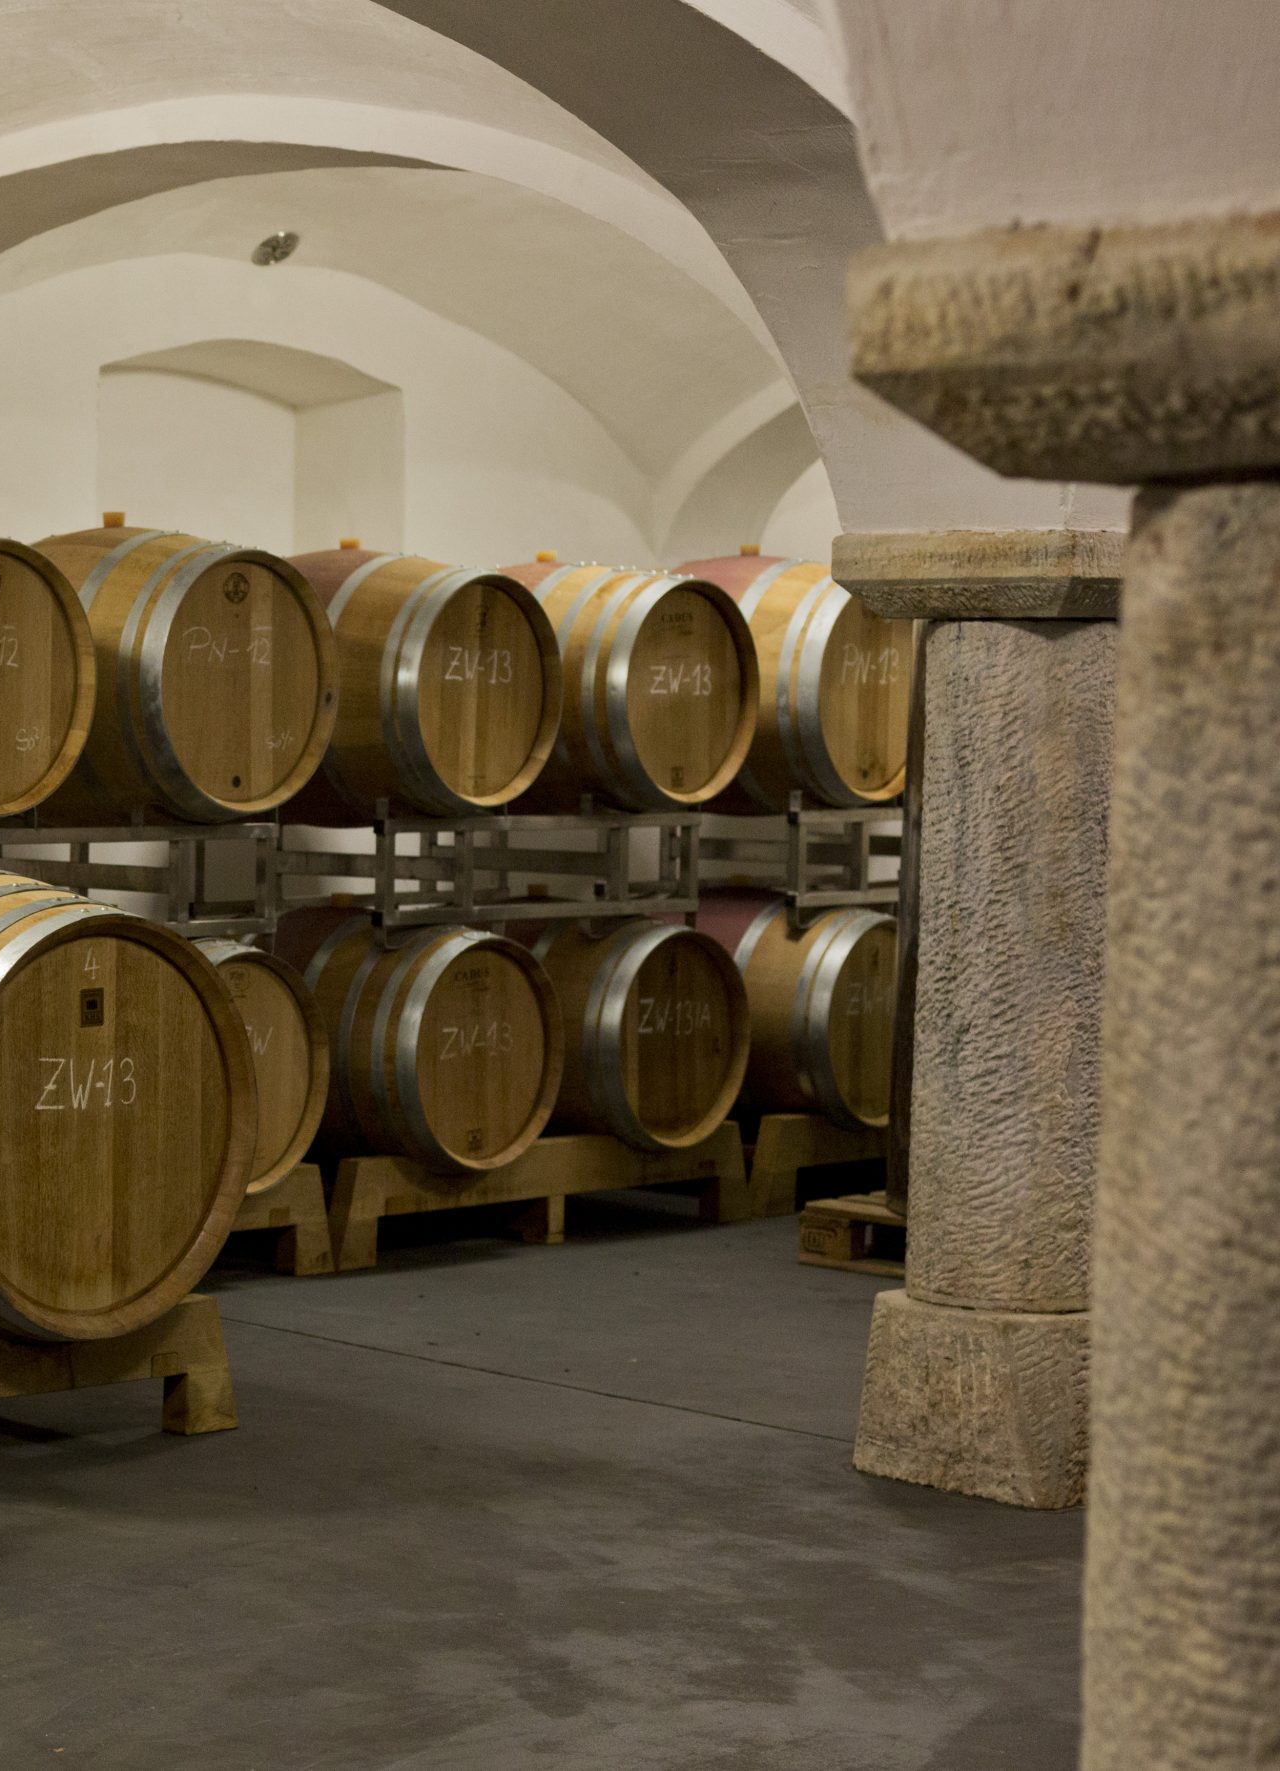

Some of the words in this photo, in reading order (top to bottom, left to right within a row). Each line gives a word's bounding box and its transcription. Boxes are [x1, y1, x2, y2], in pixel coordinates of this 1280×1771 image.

[444, 646, 513, 684] ZW-13
[650, 664, 713, 696] ZW-13
[84, 946, 100, 979] 4
[440, 1021, 514, 1060] ZW-13
[34, 1056, 137, 1110] ZW-13
